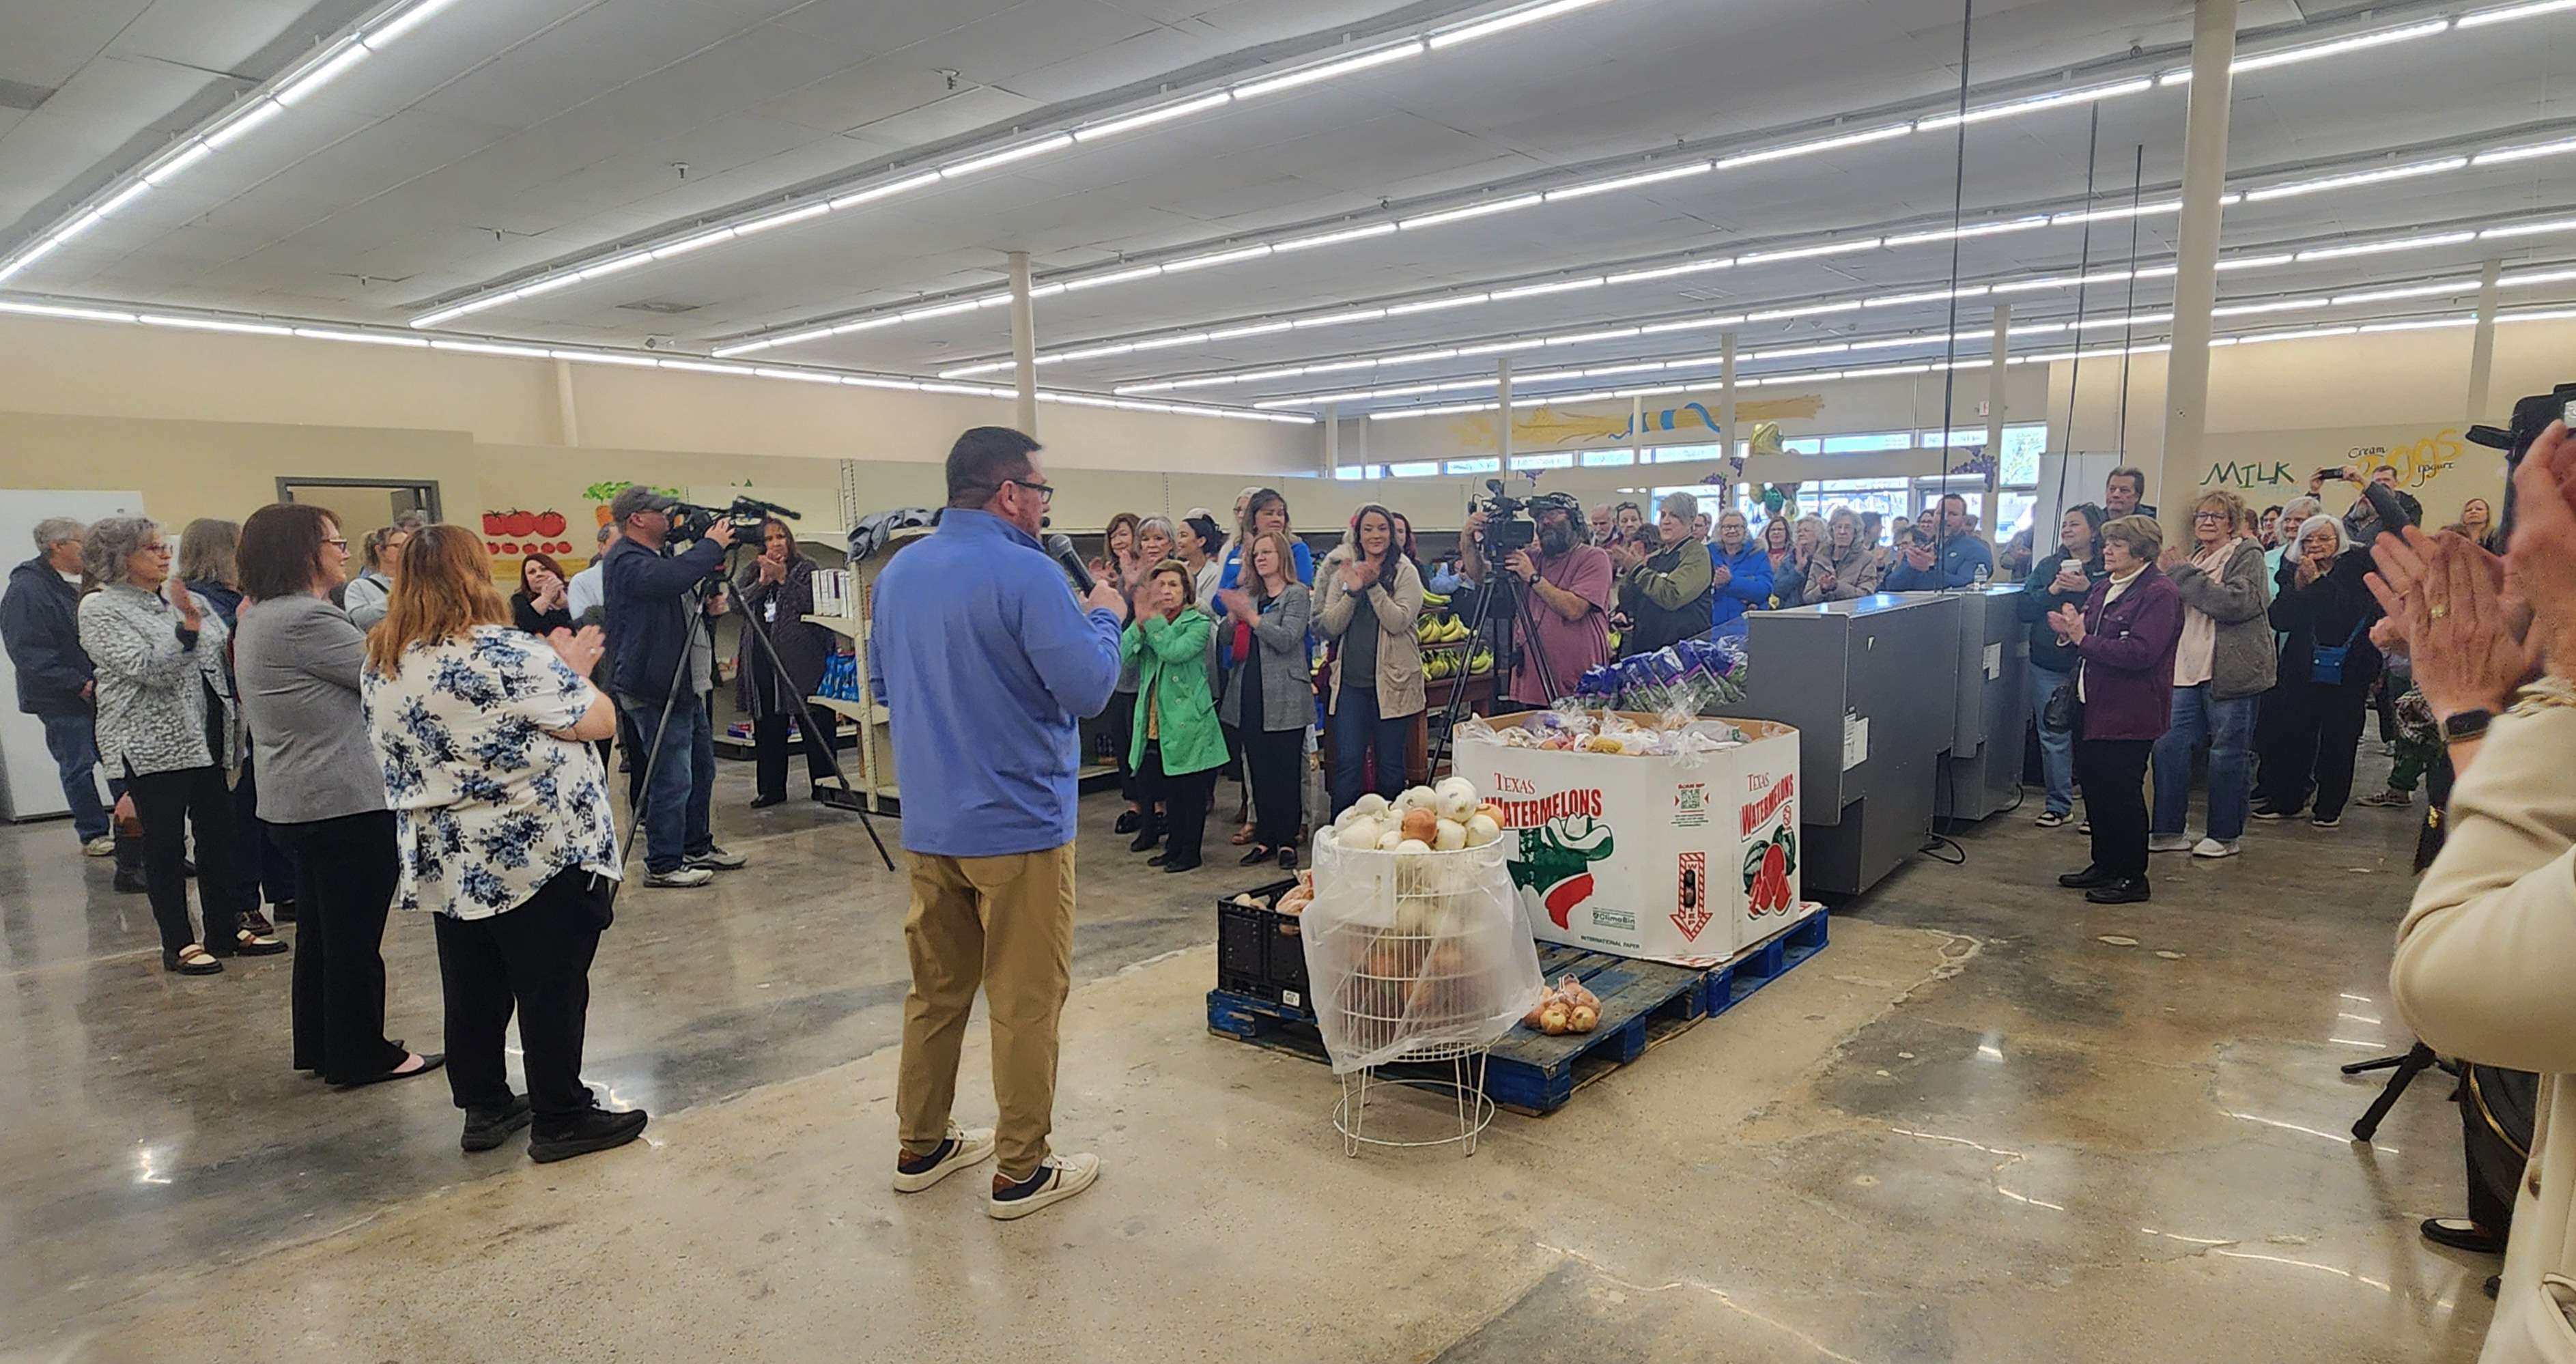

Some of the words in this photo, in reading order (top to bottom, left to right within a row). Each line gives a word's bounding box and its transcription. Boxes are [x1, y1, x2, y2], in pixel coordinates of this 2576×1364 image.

[2348, 446, 2386, 459] Cream
[2200, 461, 2295, 489] MILK
[1494, 772, 1535, 795] TEXAS
[1747, 772, 1770, 792] TEXAS
[1741, 773, 1794, 837] WATERMELONS
[1581, 935, 1622, 947] INTERNATIONAL
